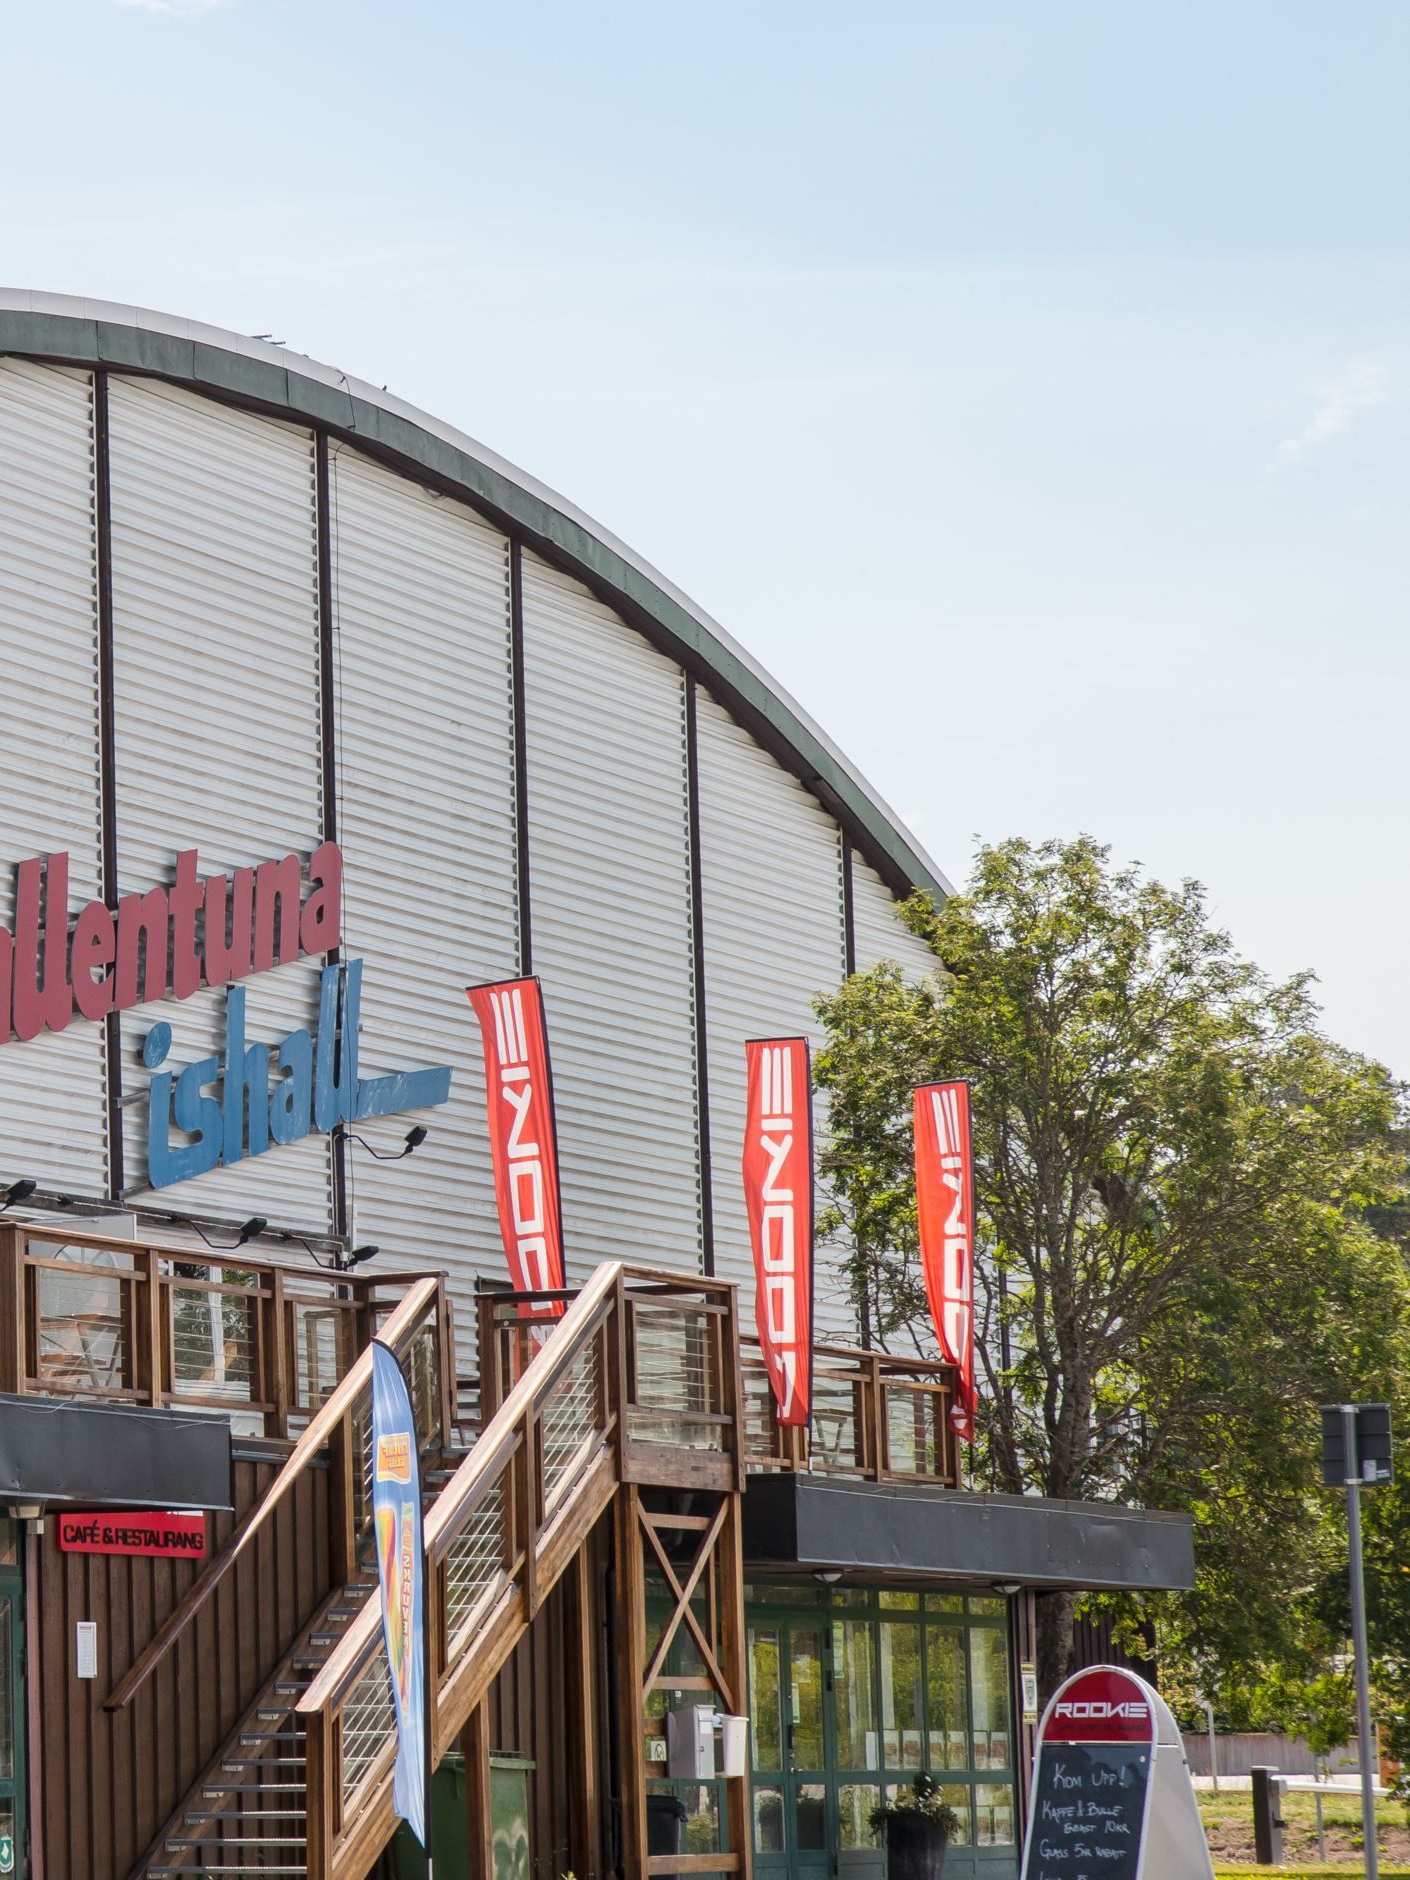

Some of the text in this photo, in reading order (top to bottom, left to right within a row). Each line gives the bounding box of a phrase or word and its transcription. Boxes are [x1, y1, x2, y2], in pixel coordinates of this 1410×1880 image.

[147, 958, 452, 1190] ishall
[63, 1519, 204, 1550] CAFÉ & RESTAURANG
[1054, 1702, 1148, 1718] ROOKIE
[1087, 1802, 1123, 1817] BULLE
